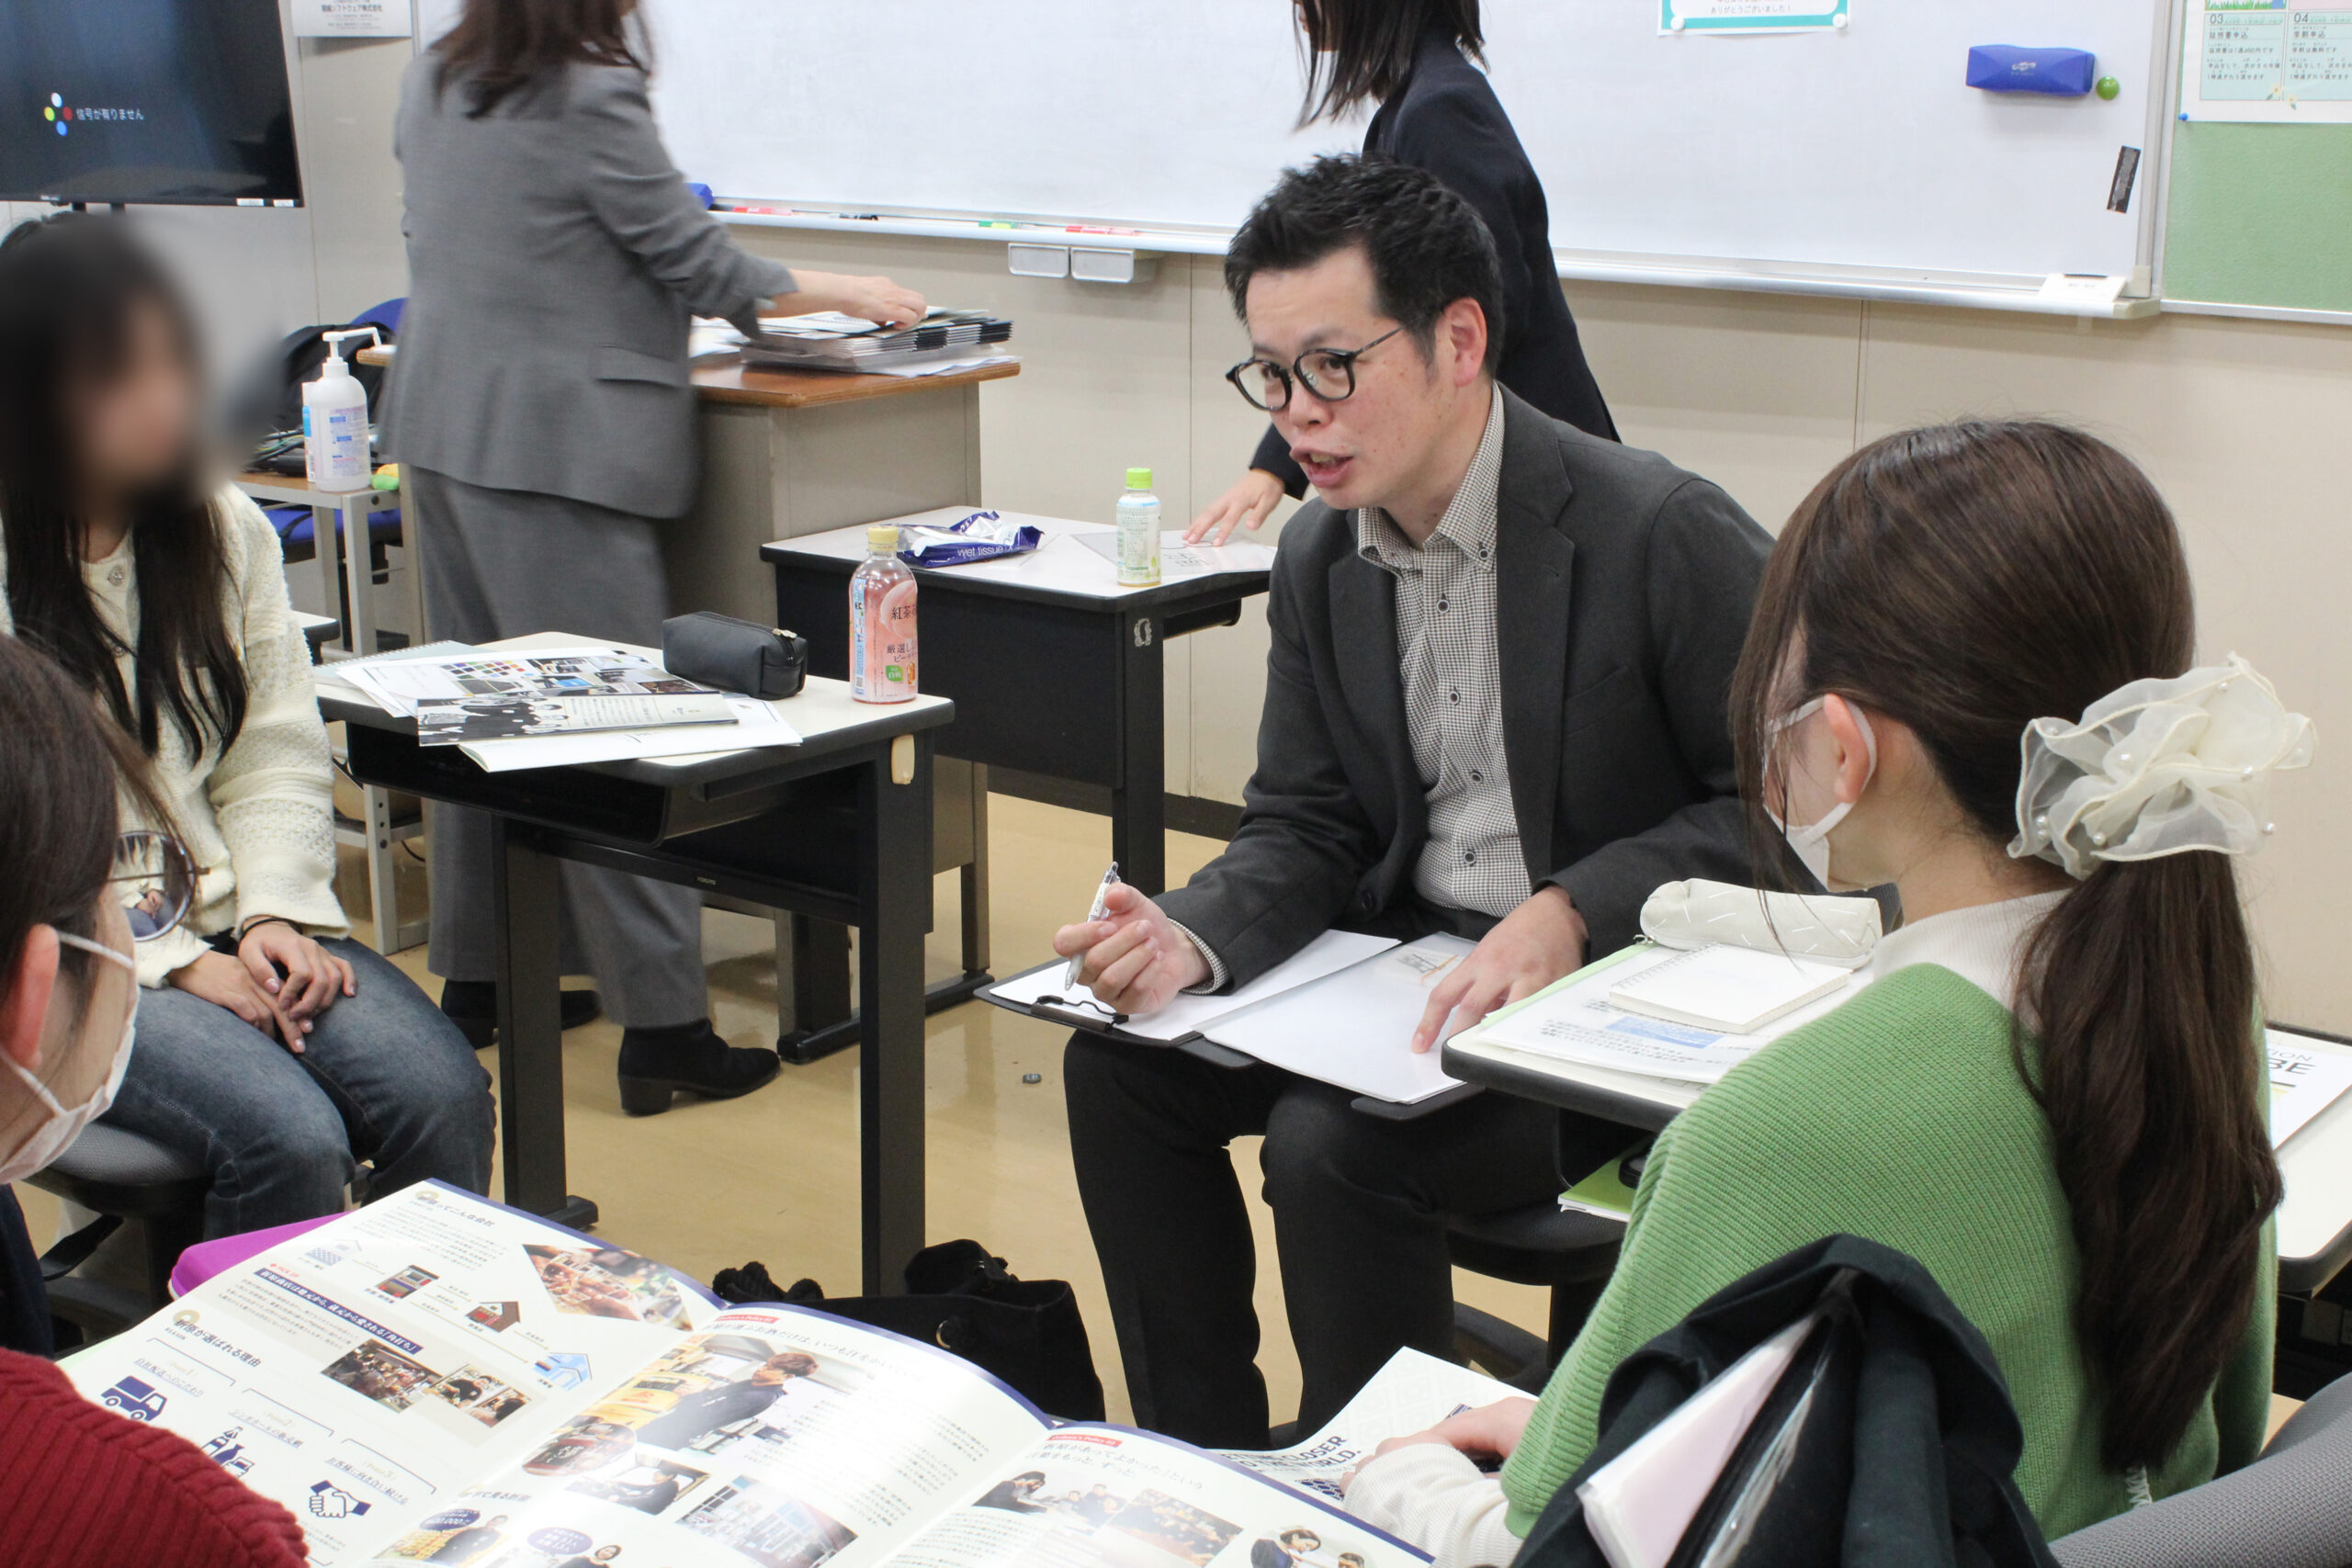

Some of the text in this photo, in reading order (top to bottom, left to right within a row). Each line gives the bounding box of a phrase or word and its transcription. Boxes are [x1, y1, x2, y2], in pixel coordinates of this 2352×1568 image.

[2210, 14, 2223, 24] 03
[2293, 13, 2308, 23] 04
[75, 107, 145, 121] 信号が有りません
[957, 546, 1004, 558] wet tissue
